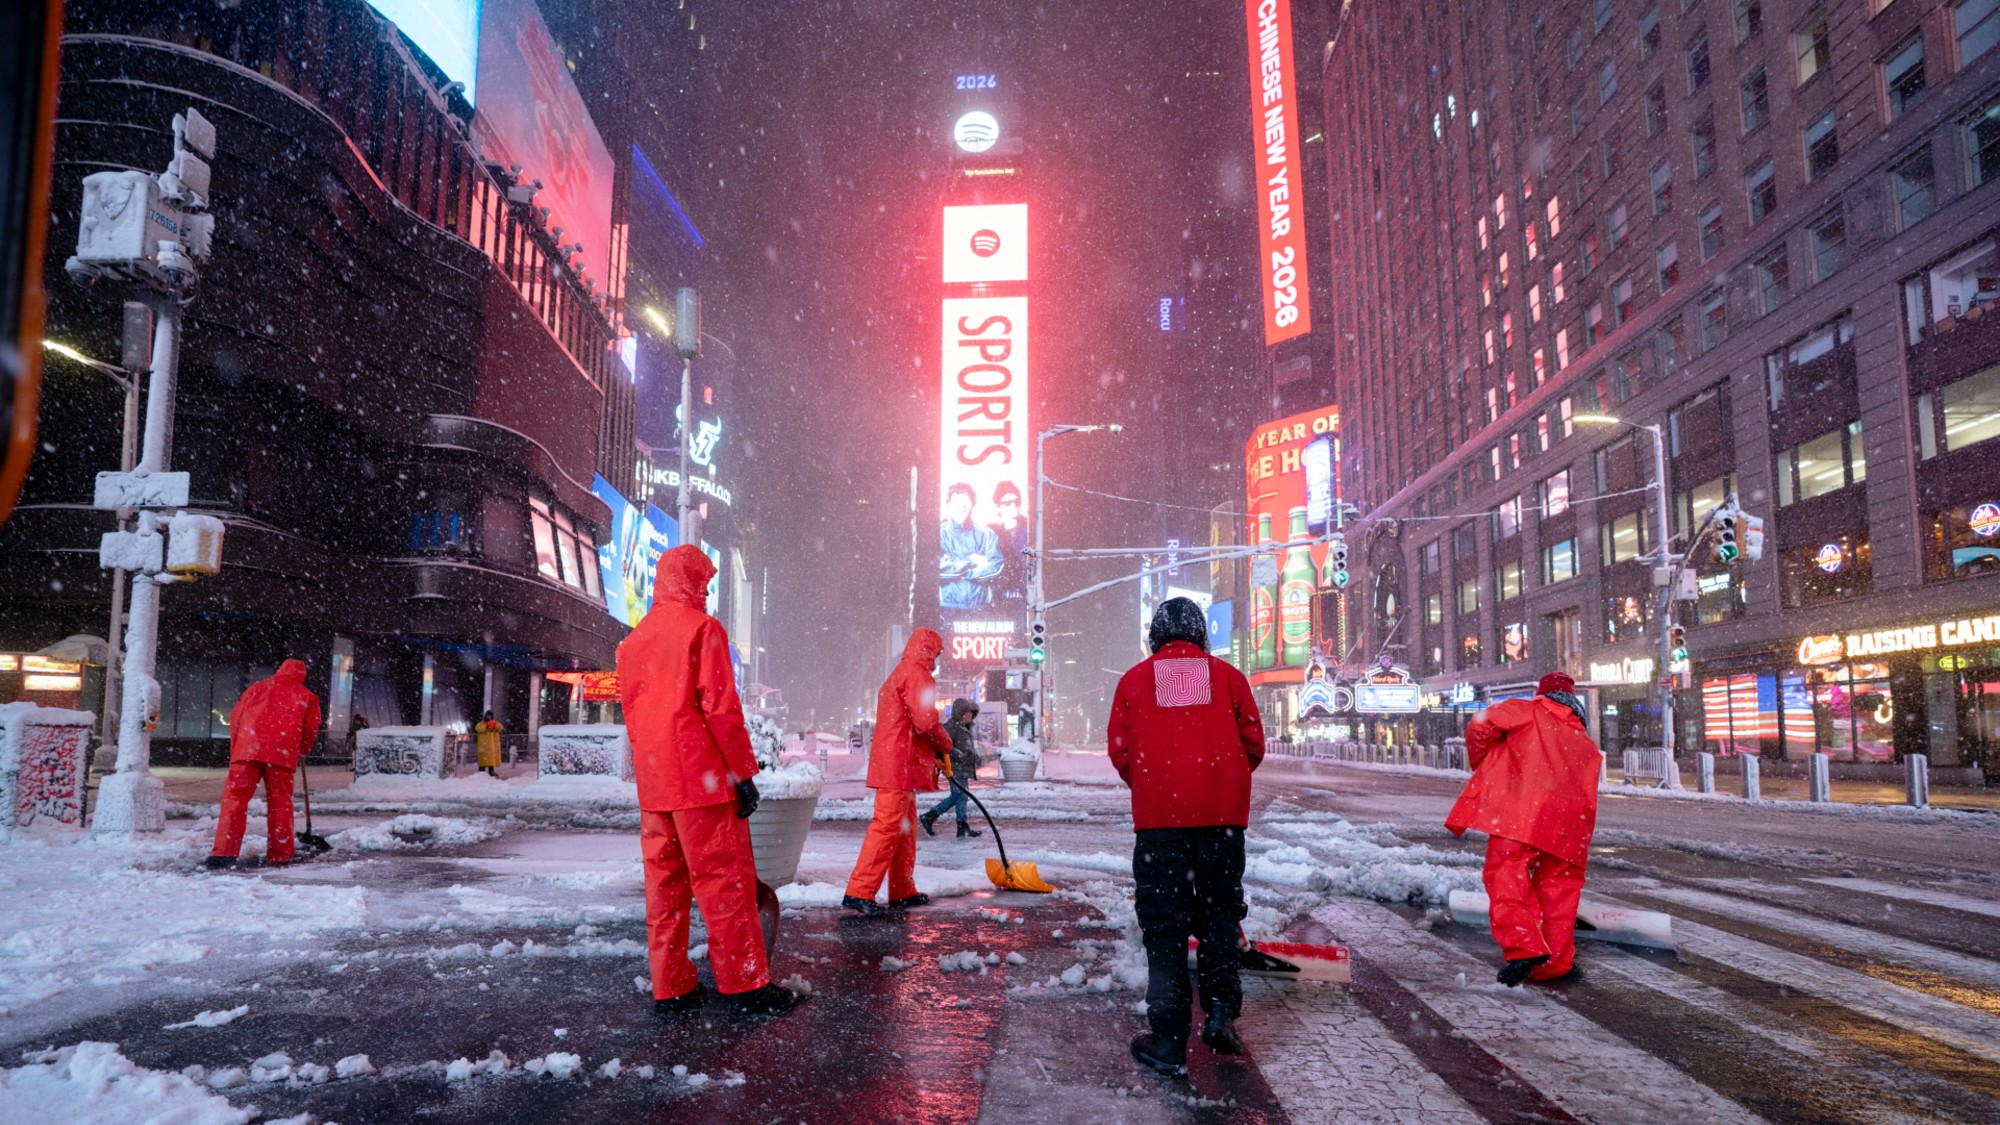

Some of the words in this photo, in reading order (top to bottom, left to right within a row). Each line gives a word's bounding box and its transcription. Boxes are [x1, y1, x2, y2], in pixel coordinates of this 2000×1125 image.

[1257, 0, 1283, 107] CHINESE
[956, 74, 997, 90] 2026
[1264, 104, 1287, 165] NEW
[1268, 166, 1291, 241] YEAR
[1271, 246, 1299, 328] 2026
[956, 315, 1013, 466] SPORTS
[1257, 422, 1307, 449] YEAR
[1312, 413, 1339, 434] OF
[953, 621, 968, 633] THE
[968, 621, 986, 633] NEW
[986, 621, 1014, 633] ALBUM
[1846, 625, 1937, 657] RAISING
[1453, 682, 1474, 703] Lids
